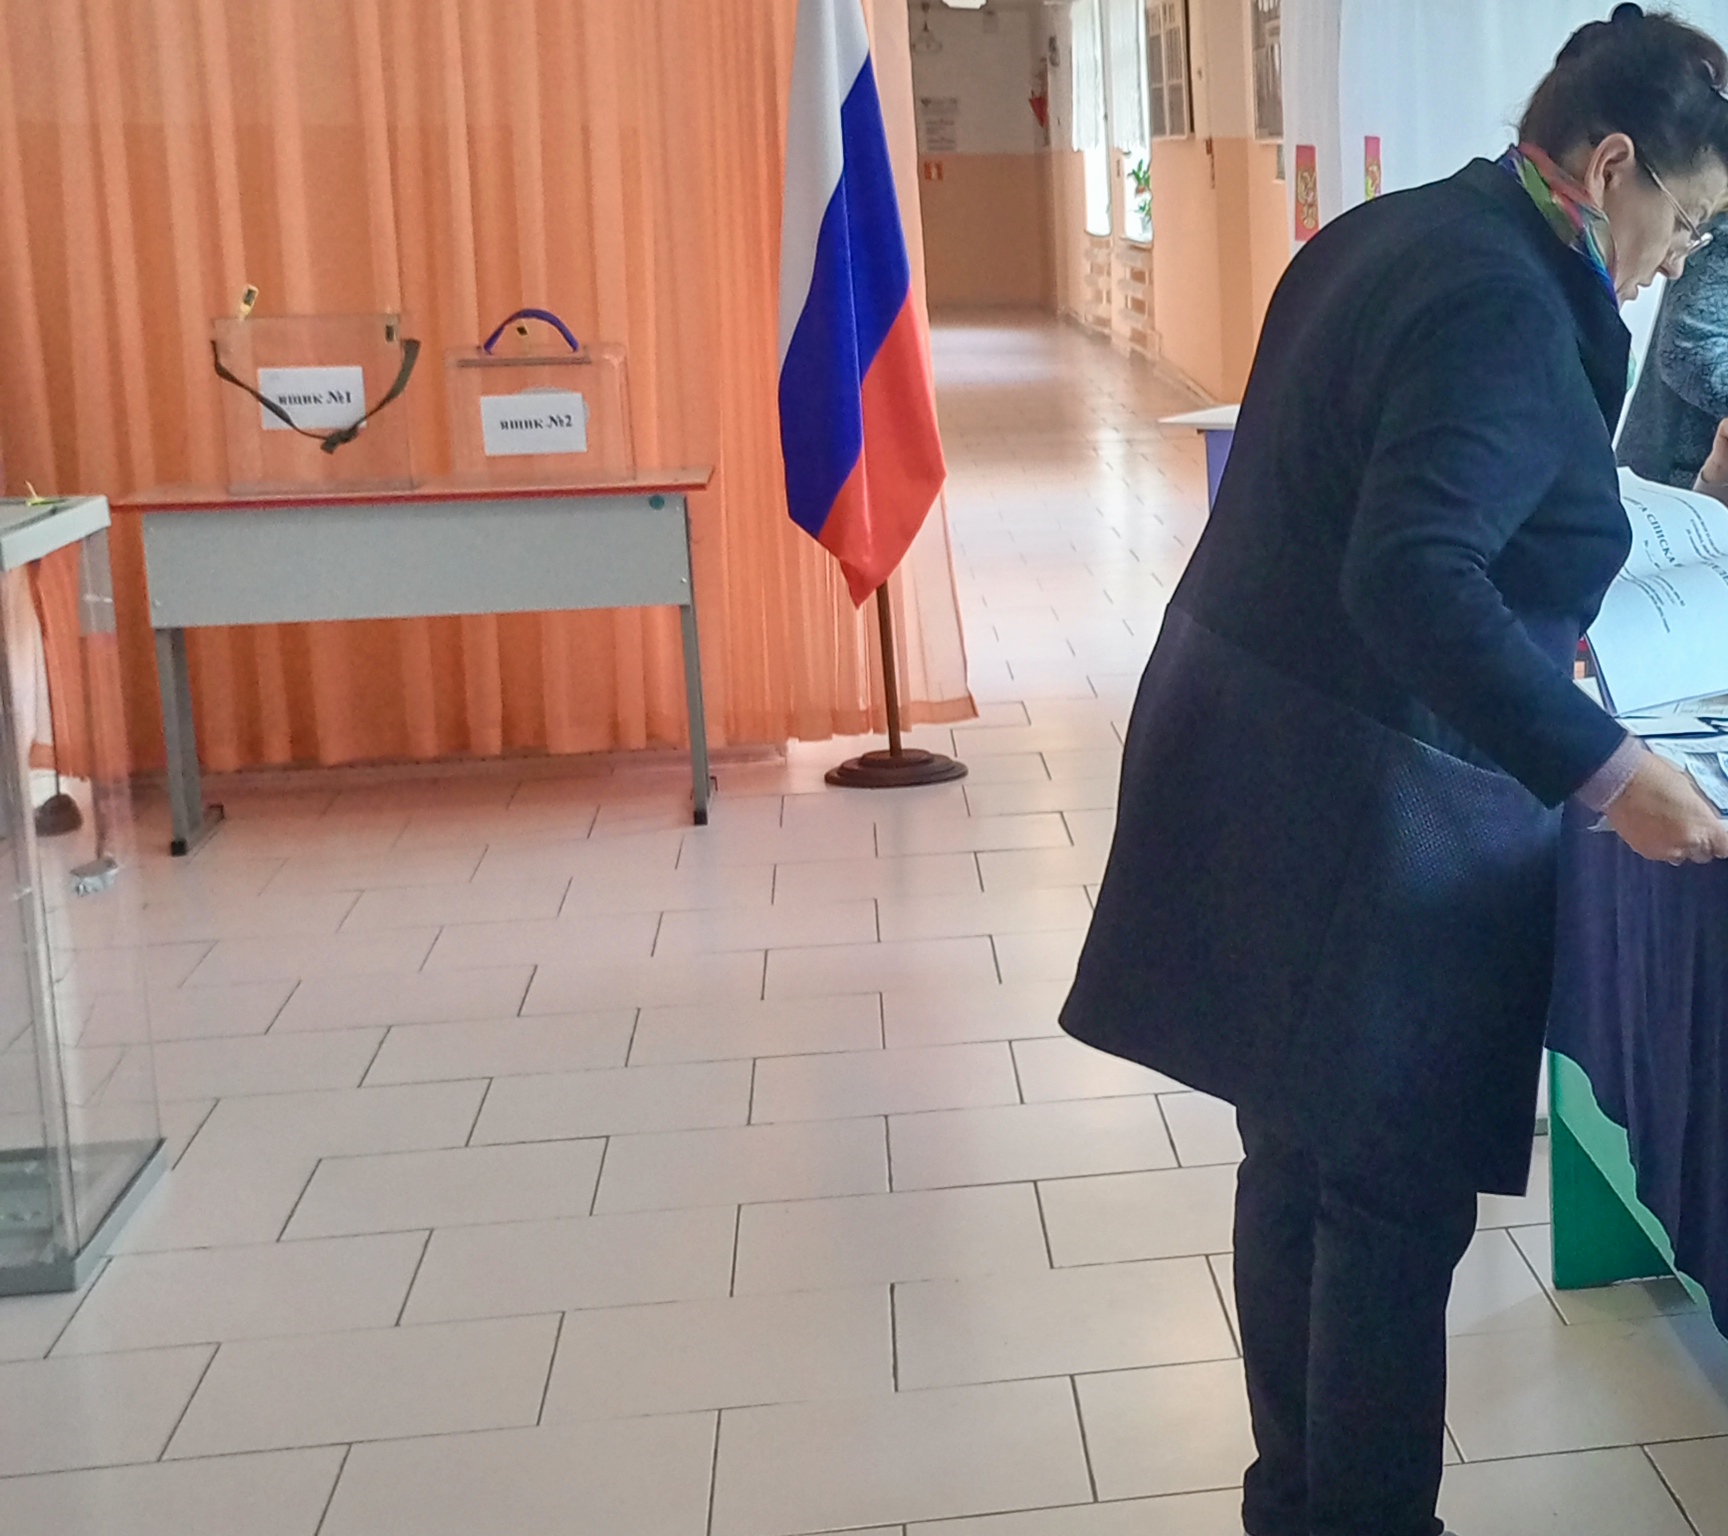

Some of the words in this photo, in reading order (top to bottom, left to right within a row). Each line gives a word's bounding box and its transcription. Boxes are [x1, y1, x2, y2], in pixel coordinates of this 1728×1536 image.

[278, 392, 323, 407] ящик
[327, 389, 352, 405] №1
[500, 416, 544, 431] ящик
[546, 413, 573, 429] №2
